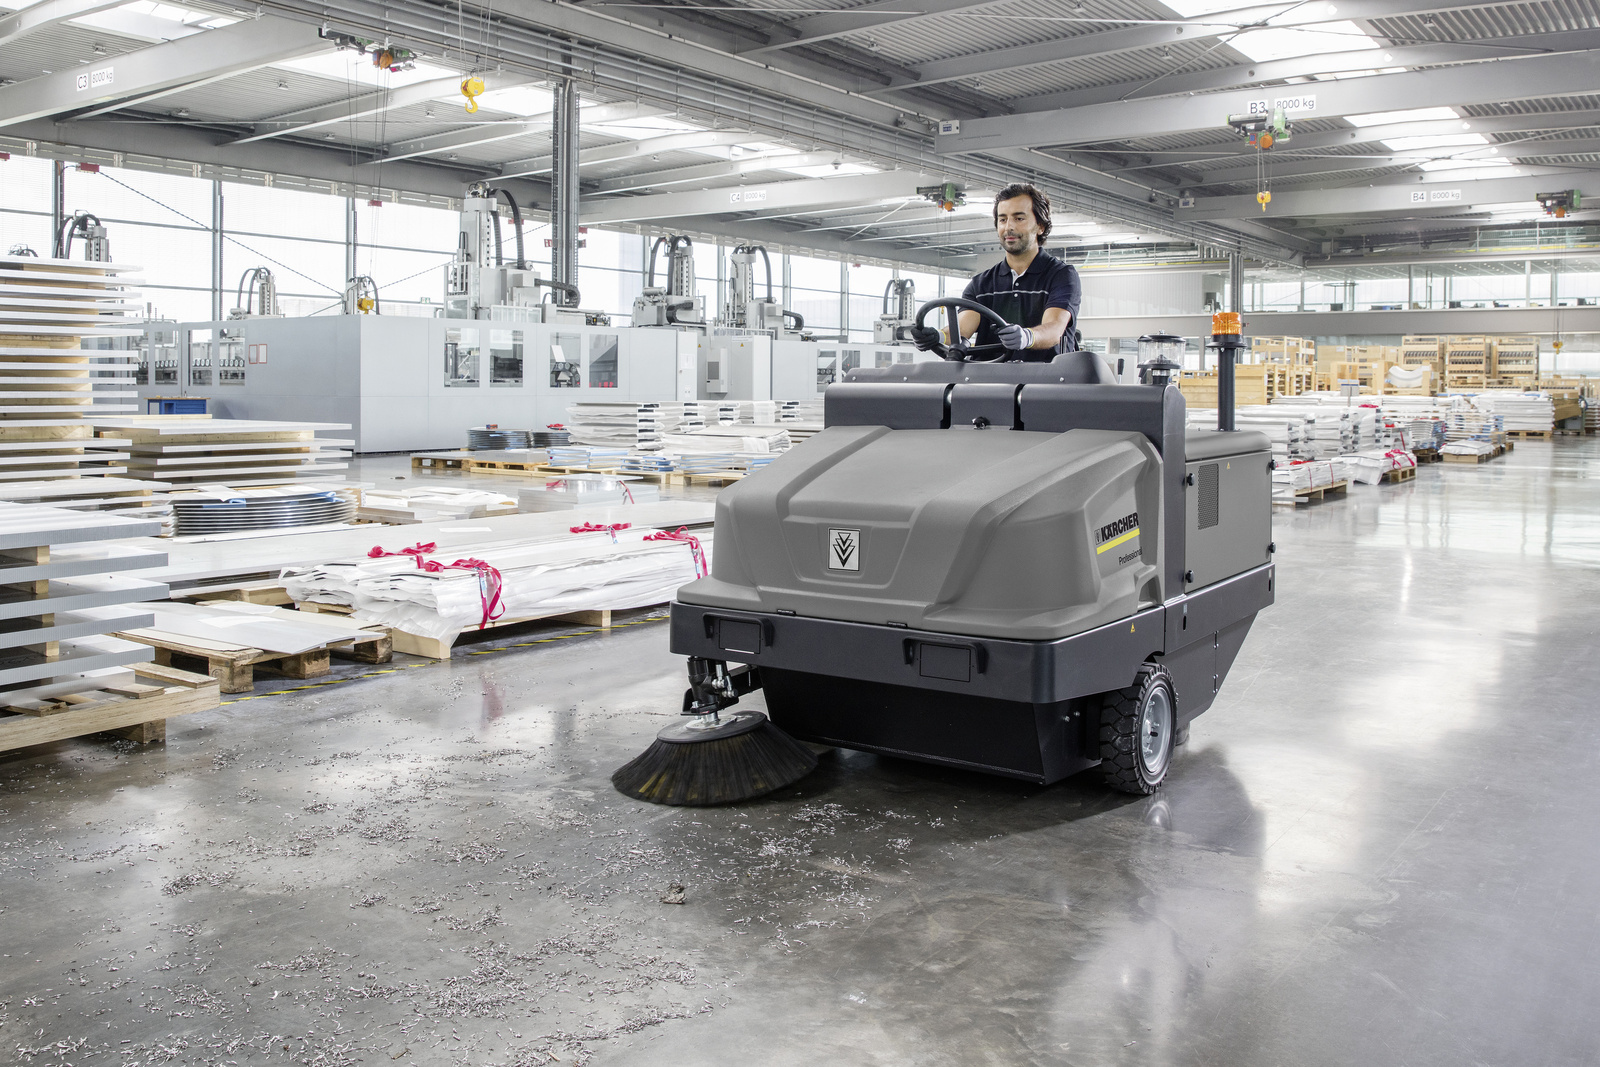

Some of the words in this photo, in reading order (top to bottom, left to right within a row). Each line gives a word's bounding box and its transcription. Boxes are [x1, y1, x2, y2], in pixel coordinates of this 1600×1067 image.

[78, 75, 88, 89] C3
[92, 71, 106, 84] 8000
[106, 69, 113, 82] kg
[1250, 101, 1266, 115] B3
[1302, 97, 1315, 110] kg
[731, 193, 740, 202] C4
[745, 192, 759, 200] 8000
[759, 191, 766, 200] kg
[1413, 192, 1425, 202] B4
[1432, 191, 1450, 200] 8000
[1451, 191, 1460, 200] kg
[1100, 512, 1139, 542] KÄRCHER
[1118, 547, 1143, 565] Professional
